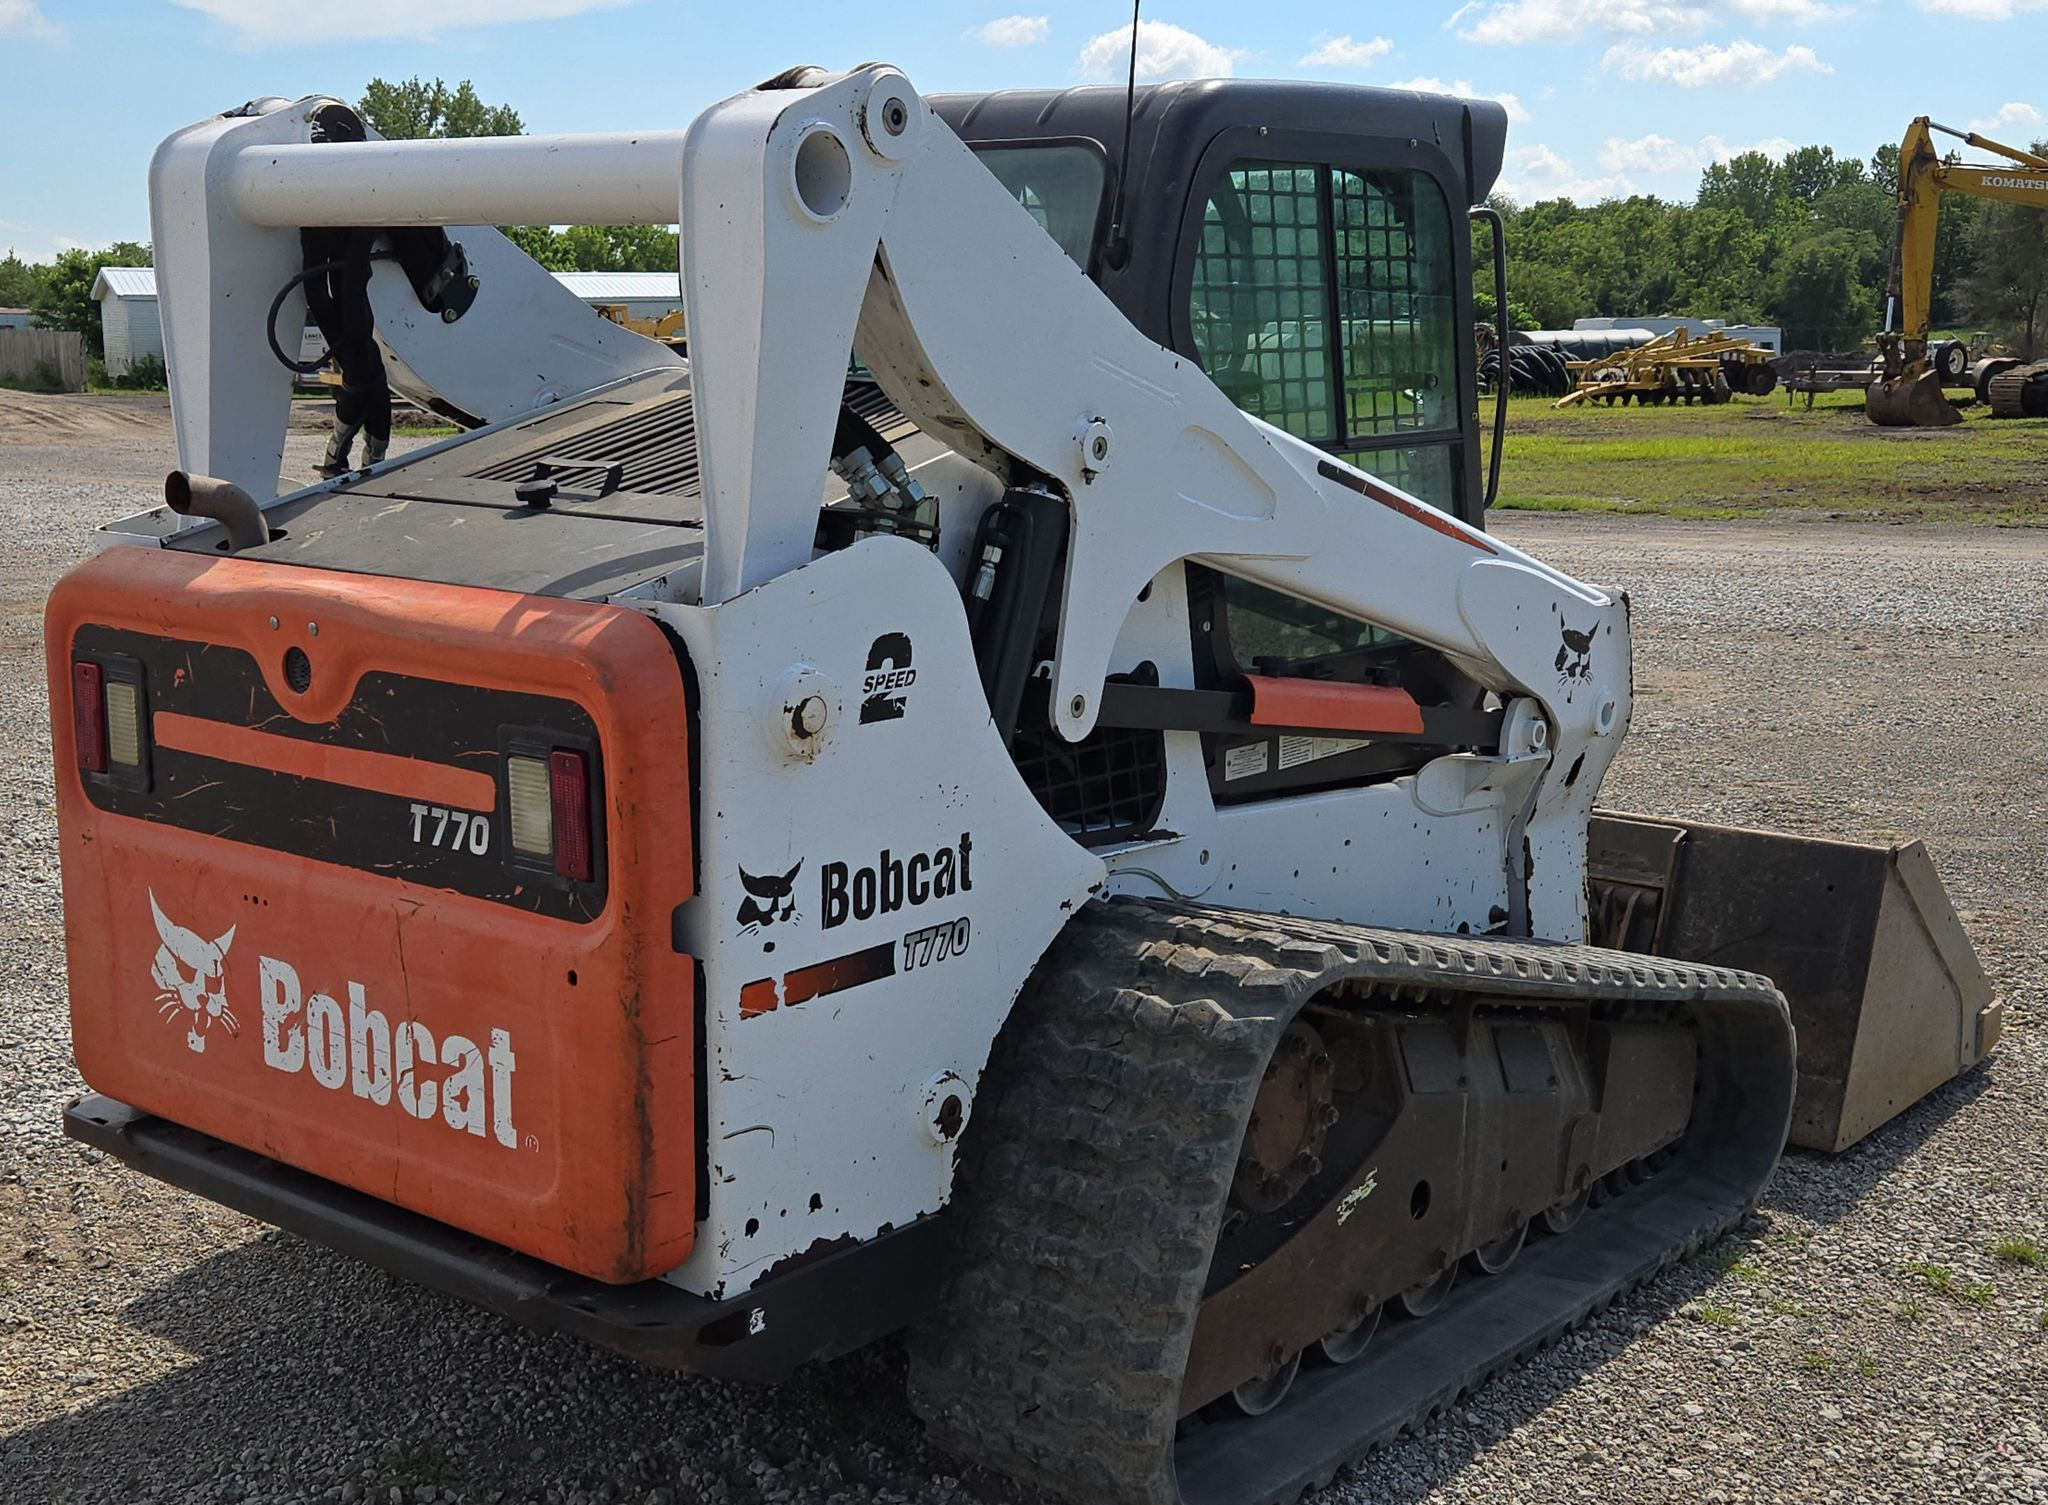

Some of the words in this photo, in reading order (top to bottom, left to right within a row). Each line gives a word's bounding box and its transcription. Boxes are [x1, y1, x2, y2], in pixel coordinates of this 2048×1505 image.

[1981, 176, 2048, 190] KOMATS
[859, 632, 912, 725] 2
[863, 669, 916, 694] SPEED
[410, 803, 489, 856] T770
[821, 832, 972, 930] Bobcat
[903, 916, 971, 972] T770
[259, 955, 517, 1149] Bobcat
